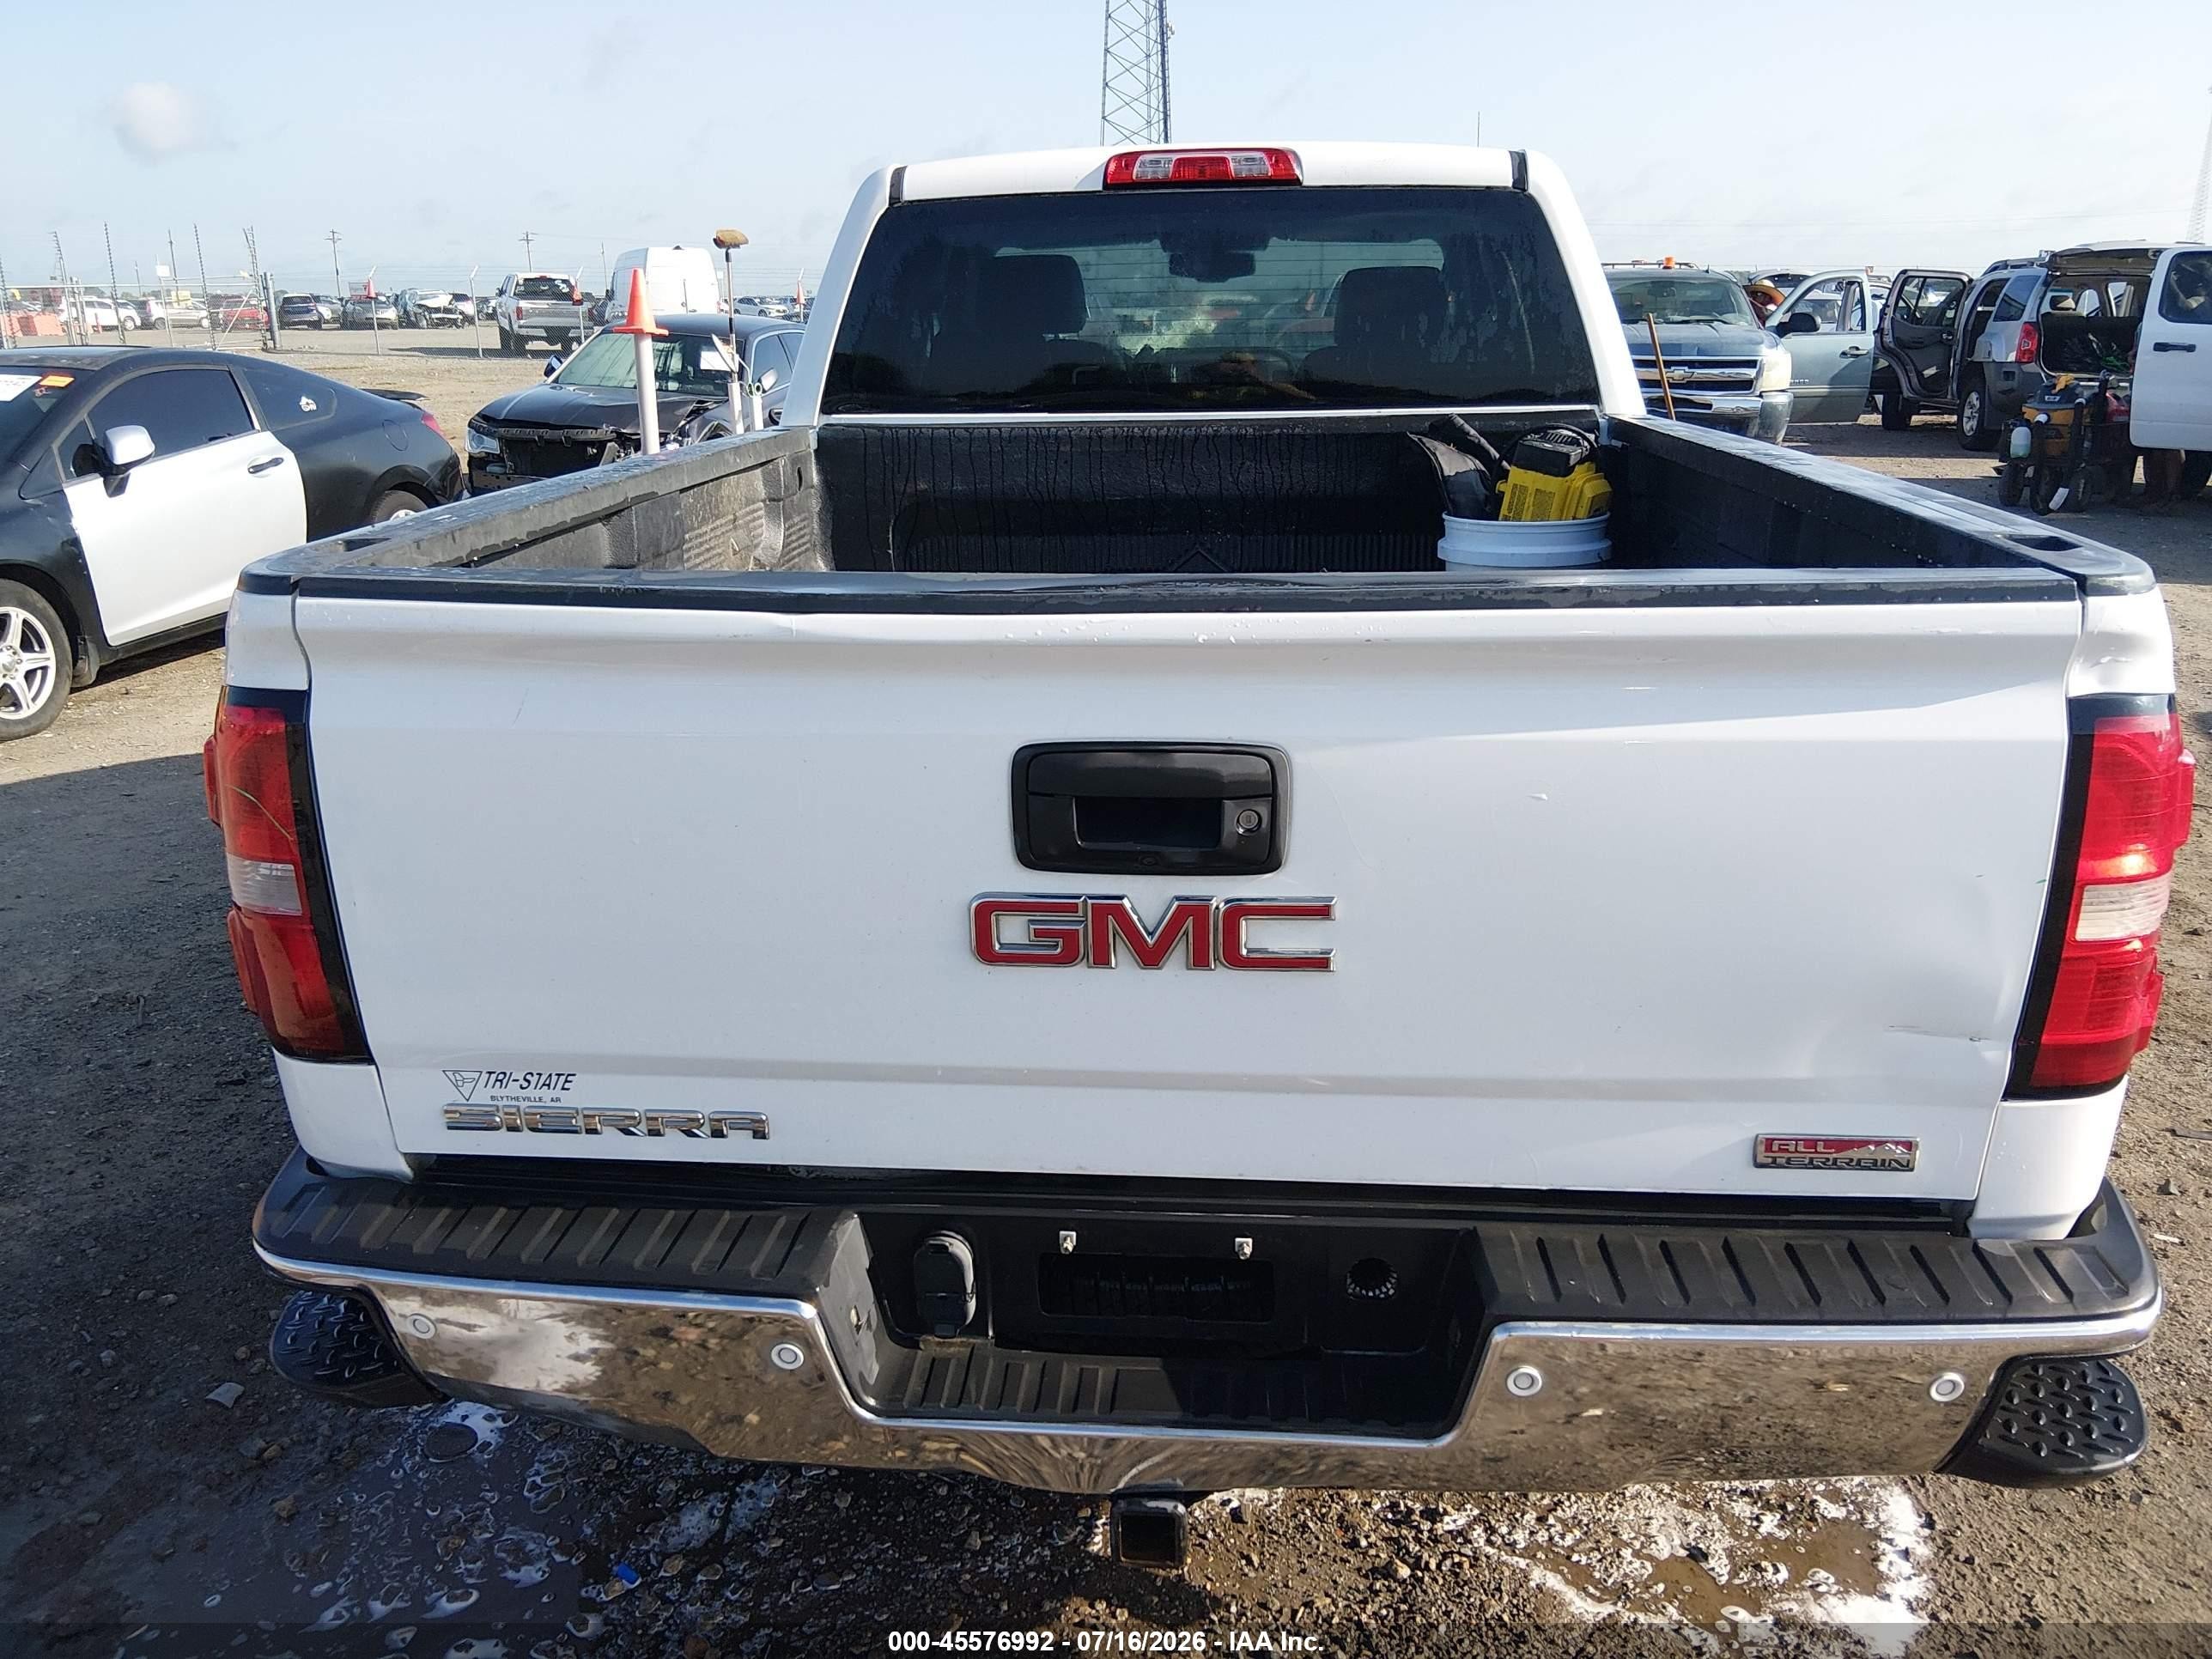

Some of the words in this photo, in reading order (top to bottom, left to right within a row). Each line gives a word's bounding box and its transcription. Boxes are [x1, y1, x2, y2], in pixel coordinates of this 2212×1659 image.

[969, 891, 1338, 971] GMC
[483, 1071, 577, 1091] TRI-STATE
[489, 1095, 547, 1103] BLYTHEVILLE,
[441, 1103, 769, 1139] SIERRA
[1771, 1140, 1834, 1152] ALL
[1764, 1155, 1910, 1170] TERRAIN
